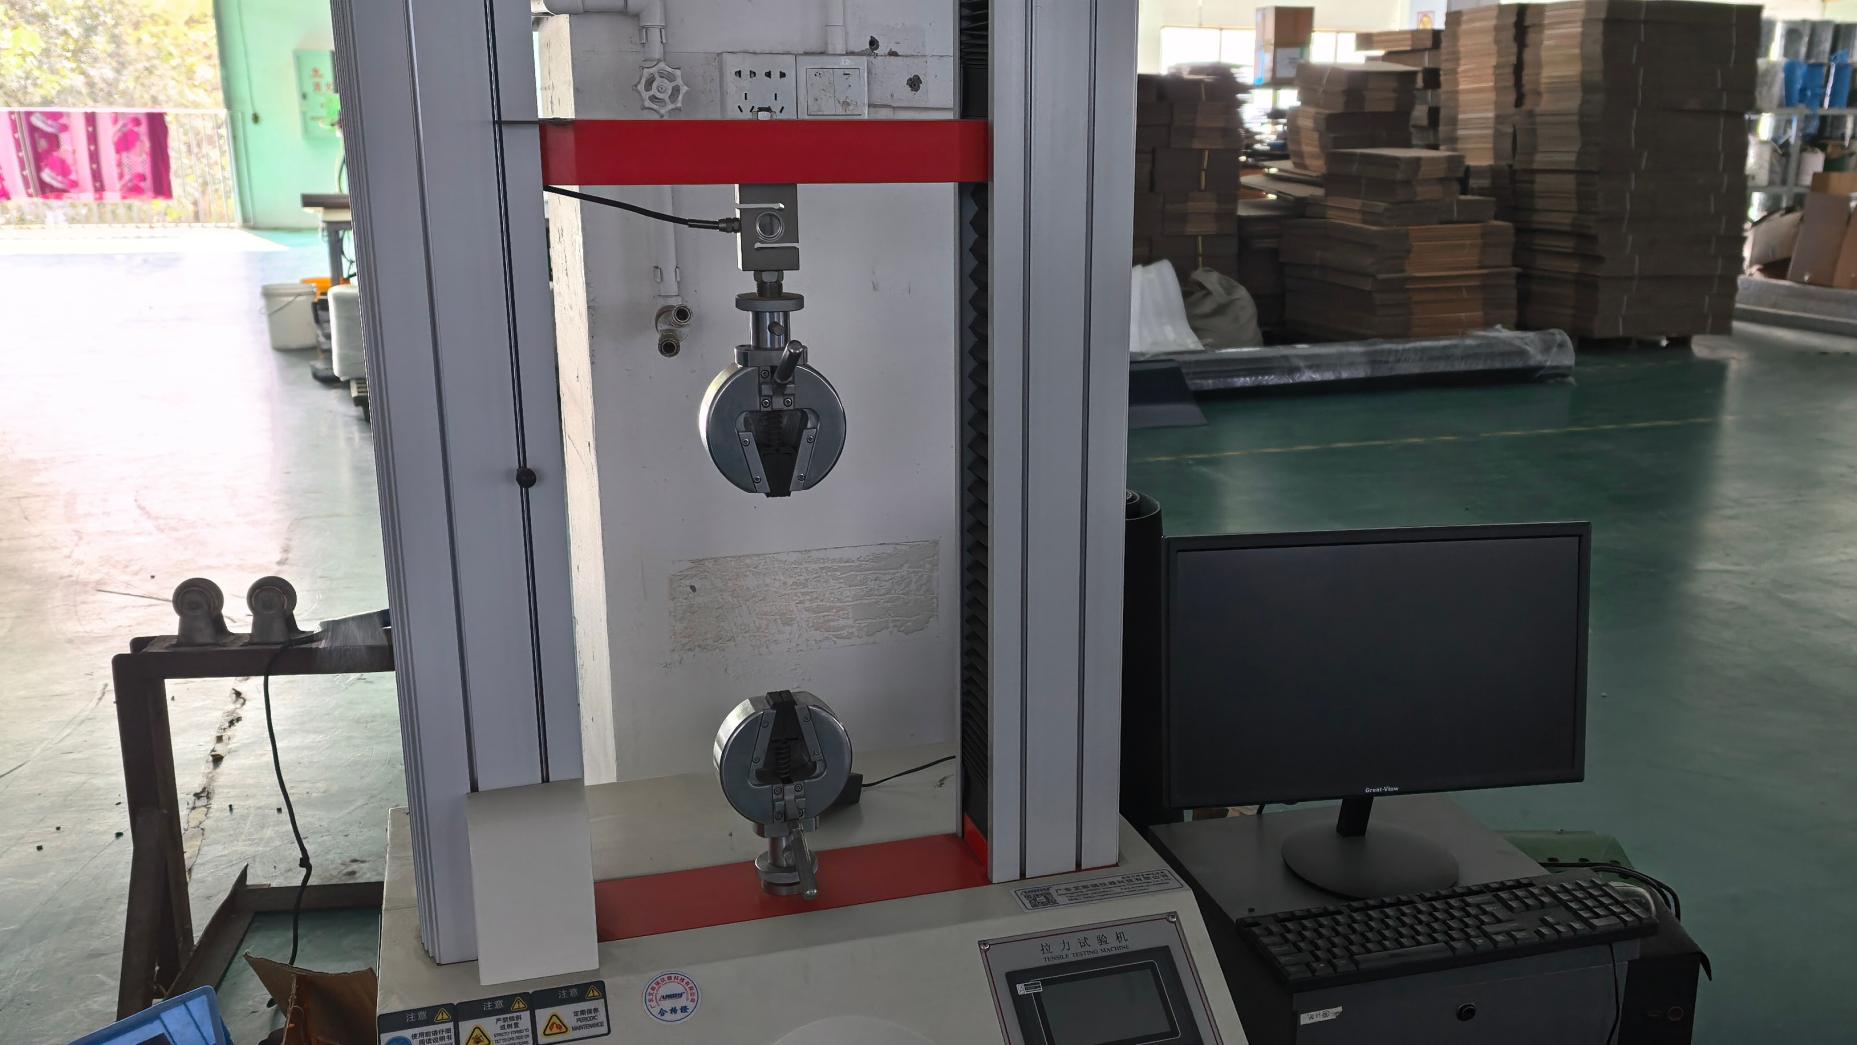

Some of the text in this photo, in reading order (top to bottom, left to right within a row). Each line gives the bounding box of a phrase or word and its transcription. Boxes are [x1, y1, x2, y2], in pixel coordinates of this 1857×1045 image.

[1041, 931, 1129, 954] 拉力试验机
[1043, 944, 1129, 962] TENSILE TESTING MACHINE
[482, 1000, 504, 1011] 注意
